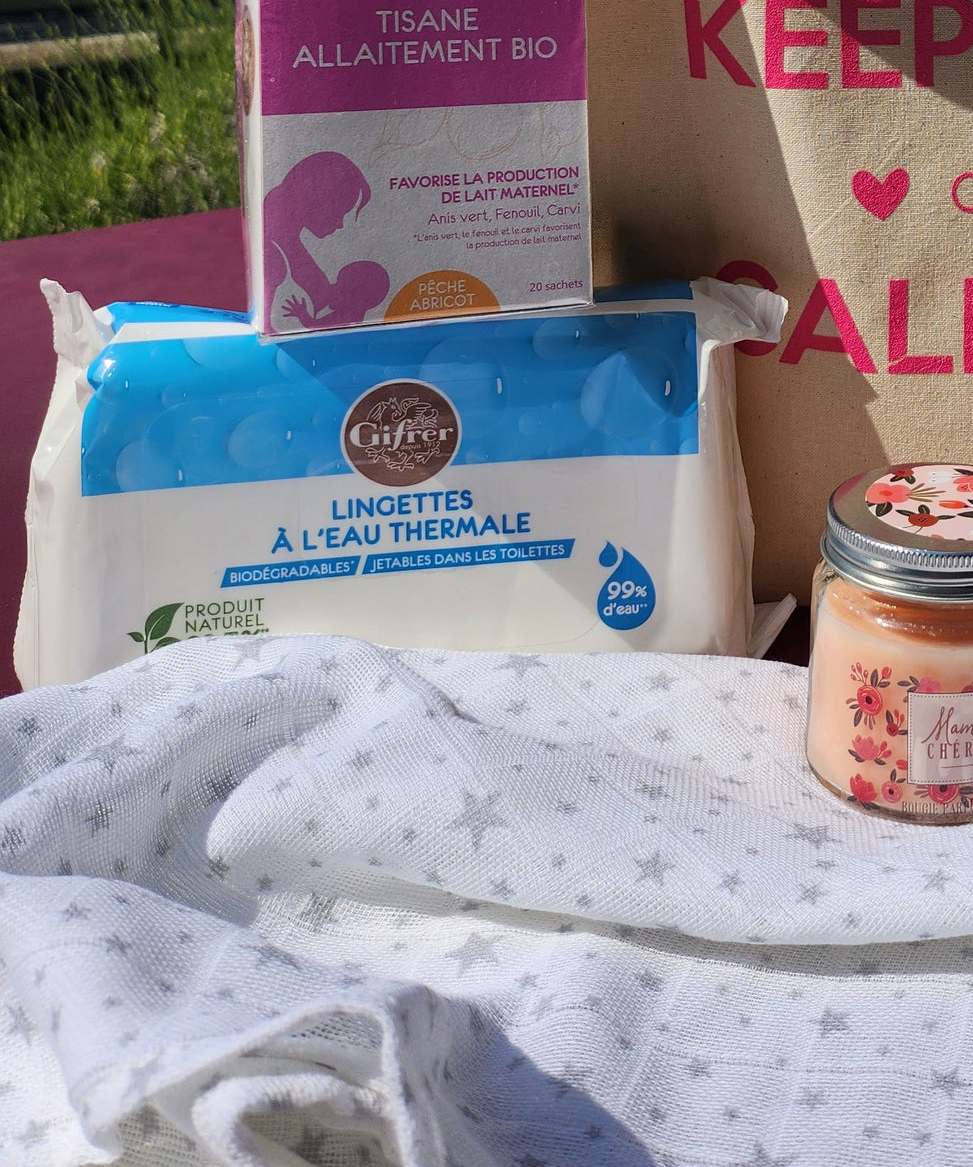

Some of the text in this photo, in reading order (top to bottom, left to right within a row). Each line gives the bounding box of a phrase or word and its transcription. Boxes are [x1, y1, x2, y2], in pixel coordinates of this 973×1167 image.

[375, 7, 479, 34] TISANE
[292, 36, 558, 69] ALLAITEMENT BIO
[389, 166, 580, 190] FAVORISE LA PRODUCTION
[441, 191, 461, 204] DE
[464, 189, 497, 202] LAIT
[427, 202, 581, 226] Anis vert, Fenouil, Carvi
[441, 232, 462, 241] vert,
[462, 230, 471, 239] le
[472, 227, 499, 238] fenouil
[501, 228, 510, 236] et
[511, 227, 520, 235] le
[521, 225, 541, 234] carvi
[542, 222, 581, 233] favorisent
[466, 233, 582, 250] la production de lait maternel
[418, 279, 466, 296] PÊCHE
[529, 278, 583, 293] 20 sachets
[409, 292, 476, 312] ABRICOT
[350, 418, 454, 452] Gifrer
[424, 440, 441, 448] 1912
[332, 489, 474, 521] LINGETTES
[271, 511, 532, 554] À L'EAU THERMALE
[369, 552, 431, 574] JETABLES
[434, 550, 473, 565] DANS
[475, 548, 498, 562] LES
[499, 543, 566, 560] TOILETTES
[607, 580, 648, 602] 99%
[185, 598, 265, 619] PRODUIT
[185, 613, 265, 633] NATUREL
[902, 800, 938, 815] BOUGIE
